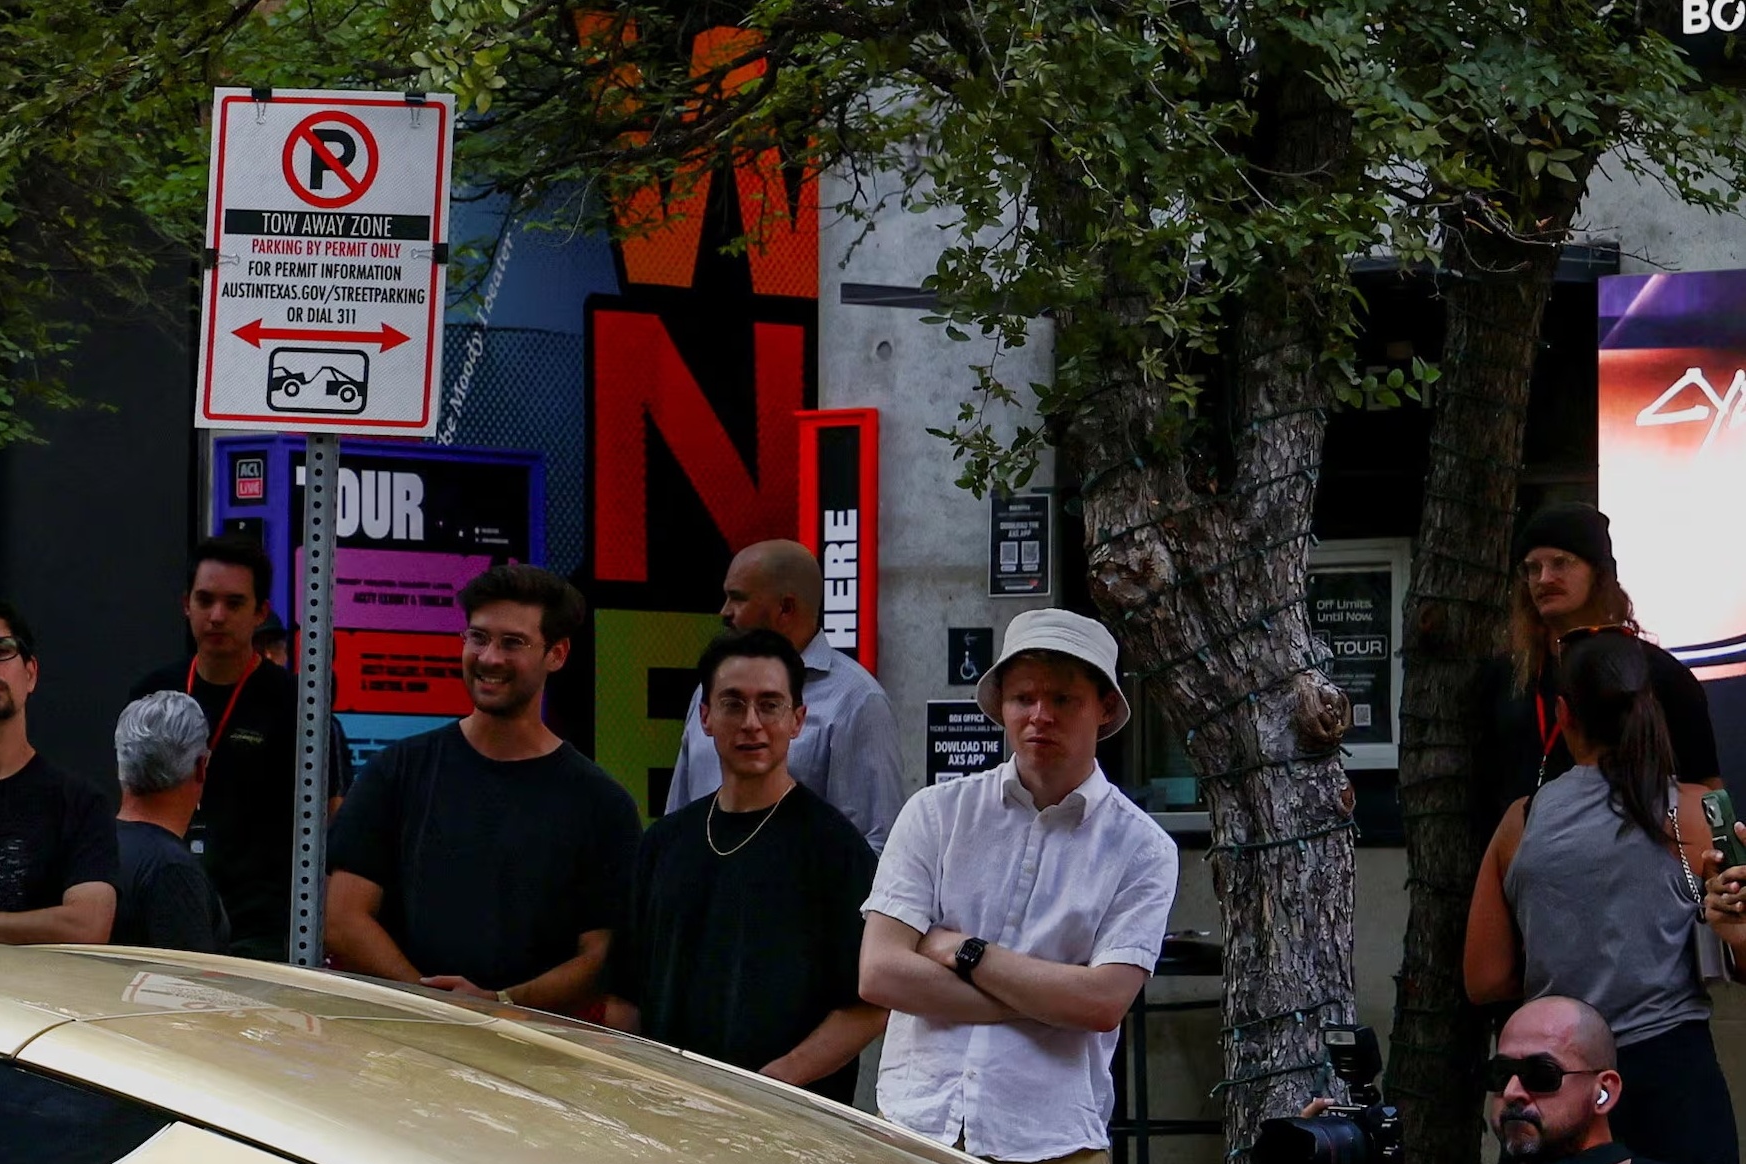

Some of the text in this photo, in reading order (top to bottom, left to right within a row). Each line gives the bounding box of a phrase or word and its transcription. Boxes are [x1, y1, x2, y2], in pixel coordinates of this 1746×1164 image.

[261, 212, 394, 238] TOW AWAY ZONE
[251, 238, 402, 259] PARKING BY PERMIT ONLY
[248, 260, 402, 281] FOR PERMIT INFORMATION
[221, 281, 426, 305] AUSTINTEXAS.GOV/STREETPARKING
[287, 306, 357, 325] OR DIAL 311
[448, 330, 484, 417] Moody
[239, 462, 260, 478] ACL
[296, 466, 425, 541] OUR
[823, 508, 857, 649] HERE
[1317, 610, 1344, 623] Until
[1333, 640, 1383, 655] TOUR
[981, 740, 999, 753] THE
[947, 753, 986, 766] AXS APP
